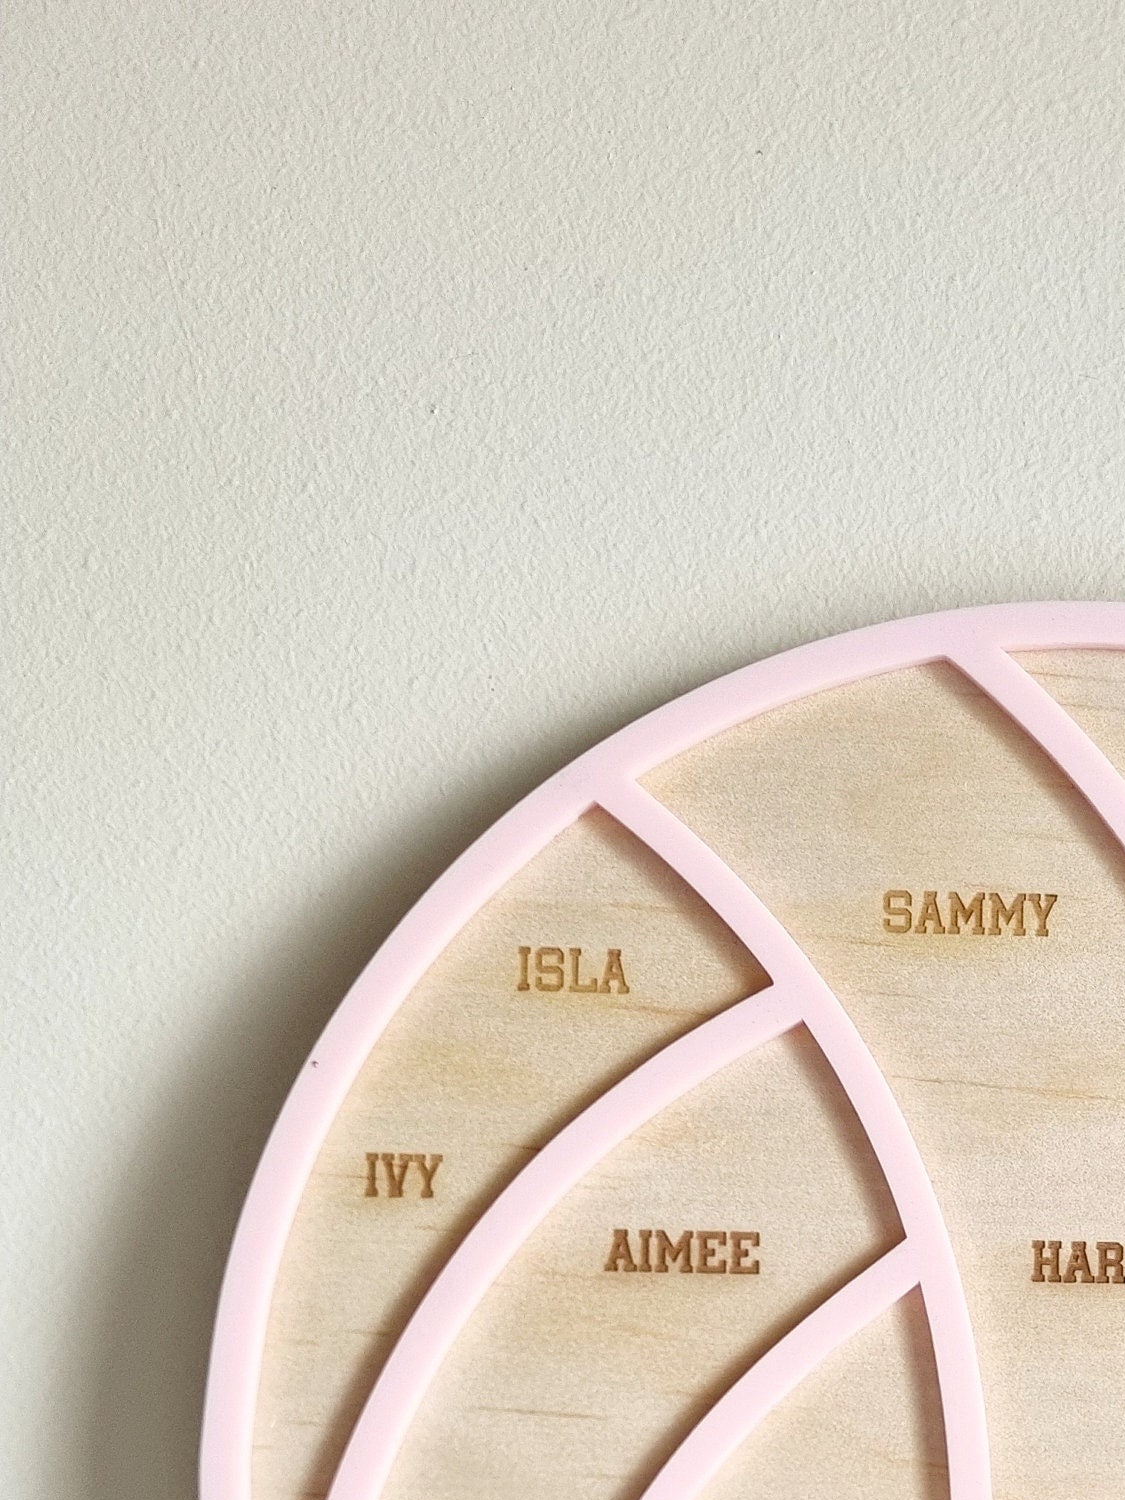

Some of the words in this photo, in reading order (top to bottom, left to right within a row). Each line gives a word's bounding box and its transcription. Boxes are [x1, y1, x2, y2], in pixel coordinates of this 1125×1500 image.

[882, 889, 1059, 938] SAMMY
[516, 945, 631, 995] ISLA
[363, 1152, 444, 1200] IVY
[603, 1228, 762, 1276] AIMEE
